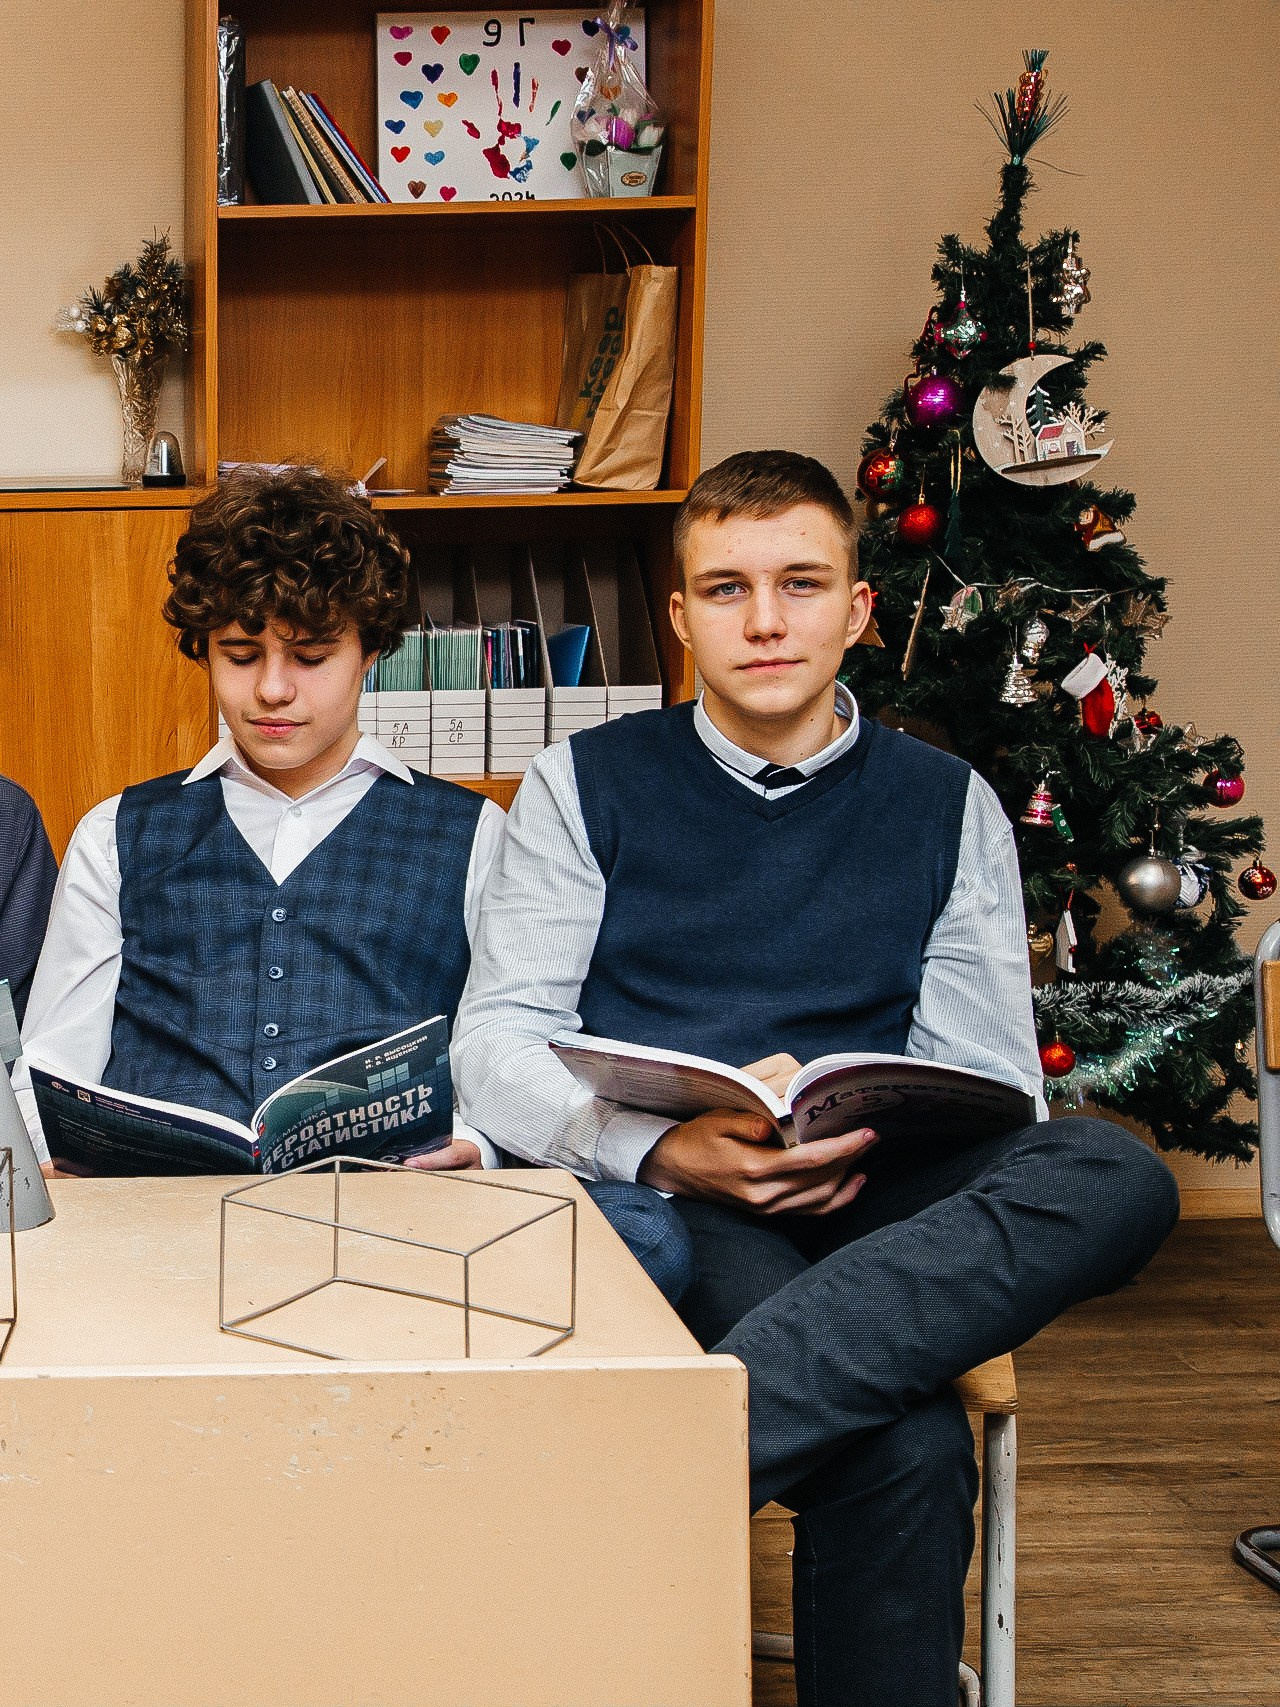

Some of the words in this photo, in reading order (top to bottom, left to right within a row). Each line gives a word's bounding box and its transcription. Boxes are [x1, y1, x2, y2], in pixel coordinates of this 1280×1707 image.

[482, 18, 502, 47] 9
[519, 17, 535, 47] Г
[262, 1083, 433, 1174] ВЕРОЯТНОСТЬ
[281, 1099, 433, 1169] СТАТИСТИКА
